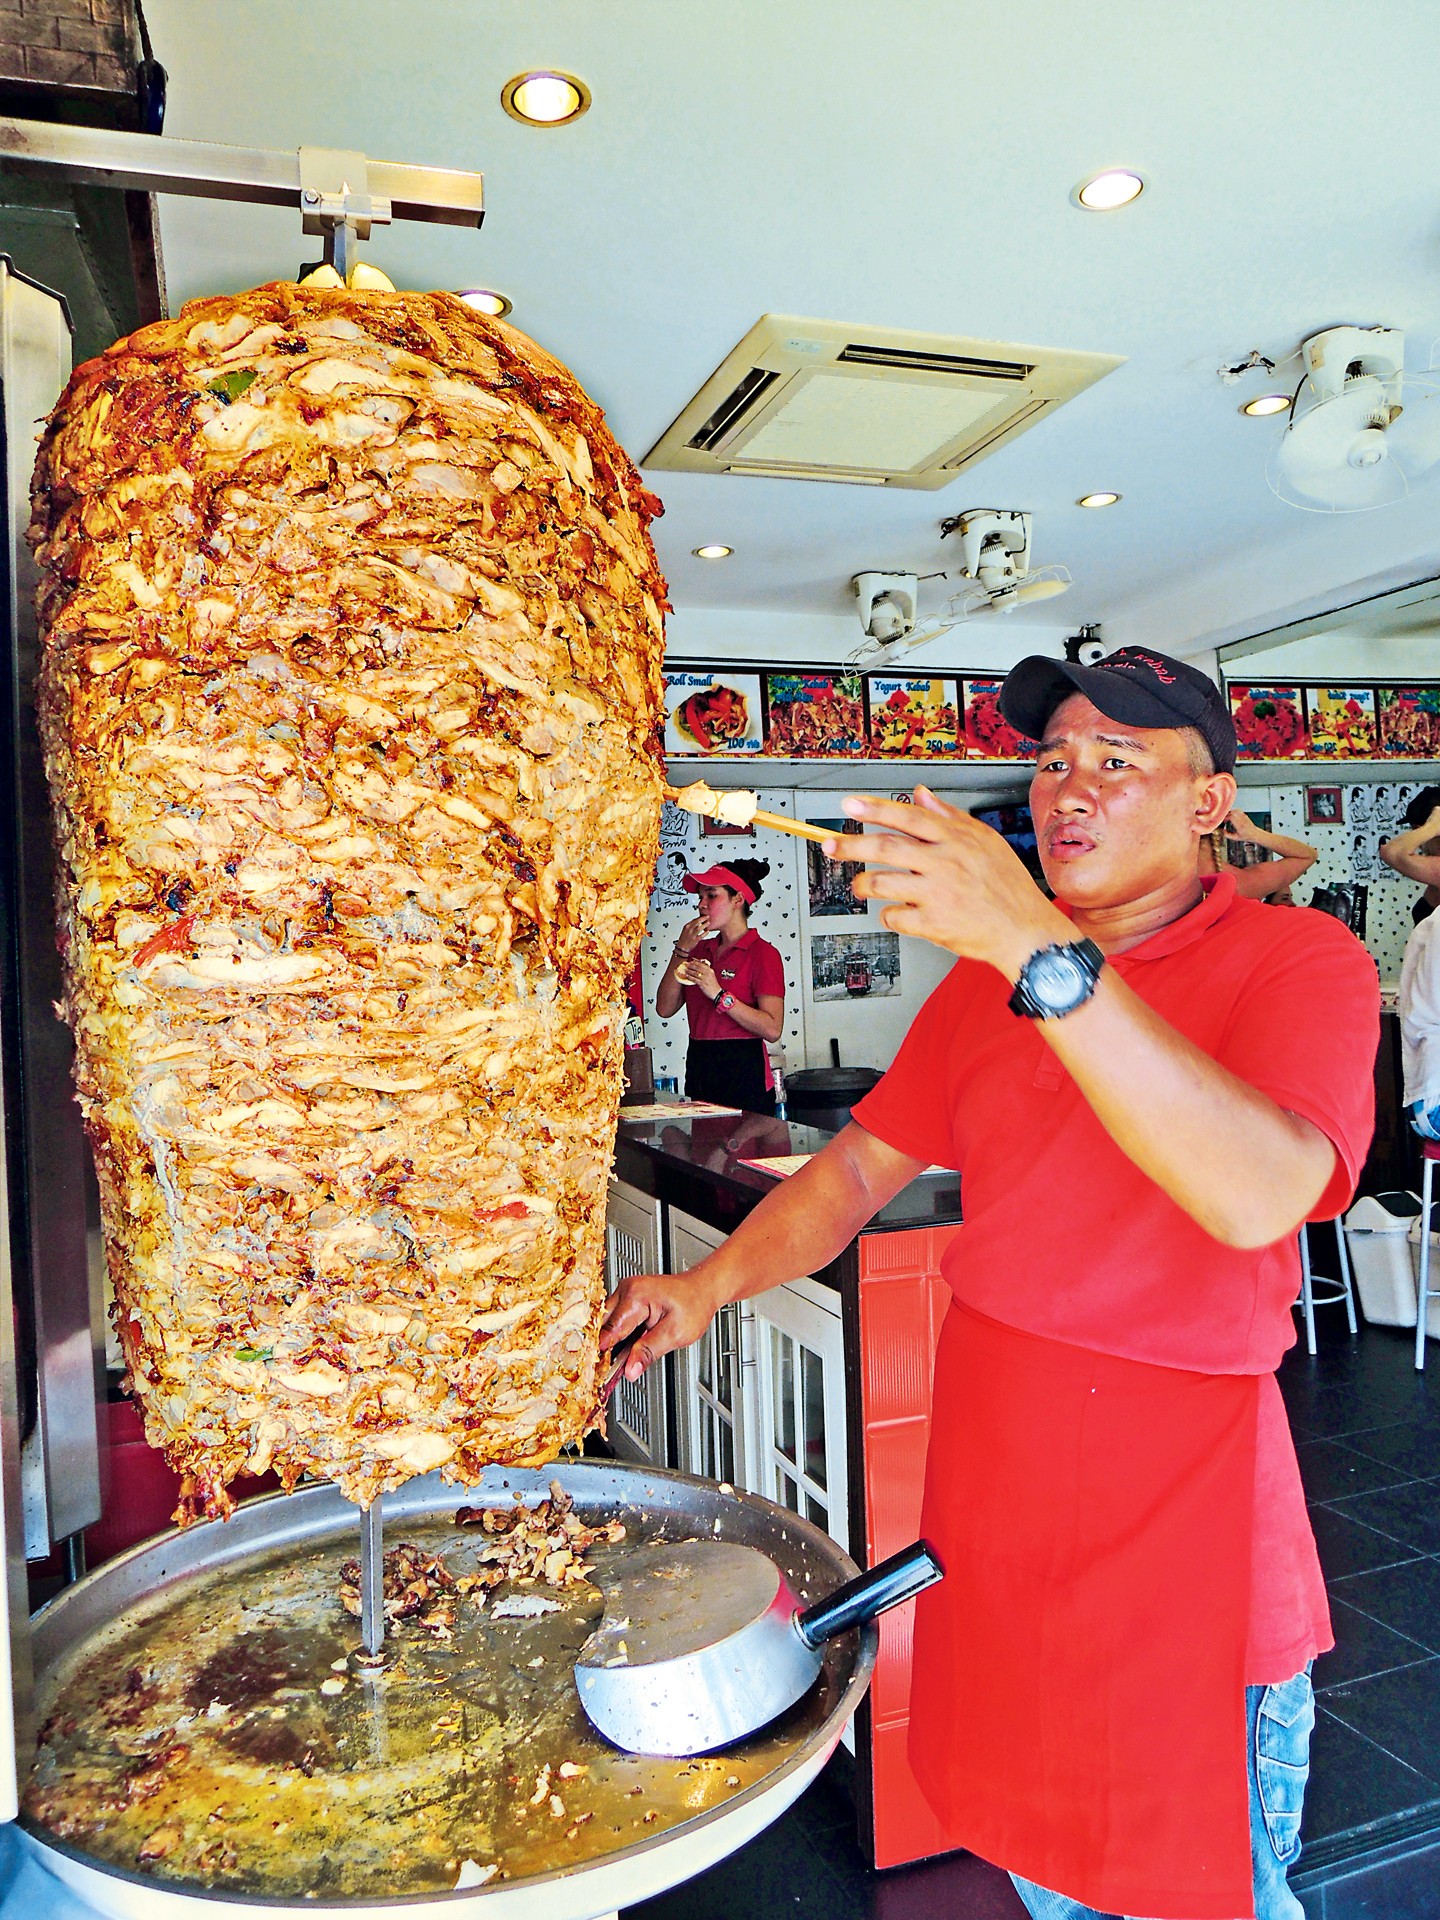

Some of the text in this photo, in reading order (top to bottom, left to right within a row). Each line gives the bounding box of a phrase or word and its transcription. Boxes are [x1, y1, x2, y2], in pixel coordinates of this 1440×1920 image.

[667, 674, 714, 686] Roll Small
[874, 680, 930, 695] Yogurt Kebab
[727, 738, 745, 749] 100
[926, 740, 943, 752] 250
[626, 1019, 642, 1041] Tip
